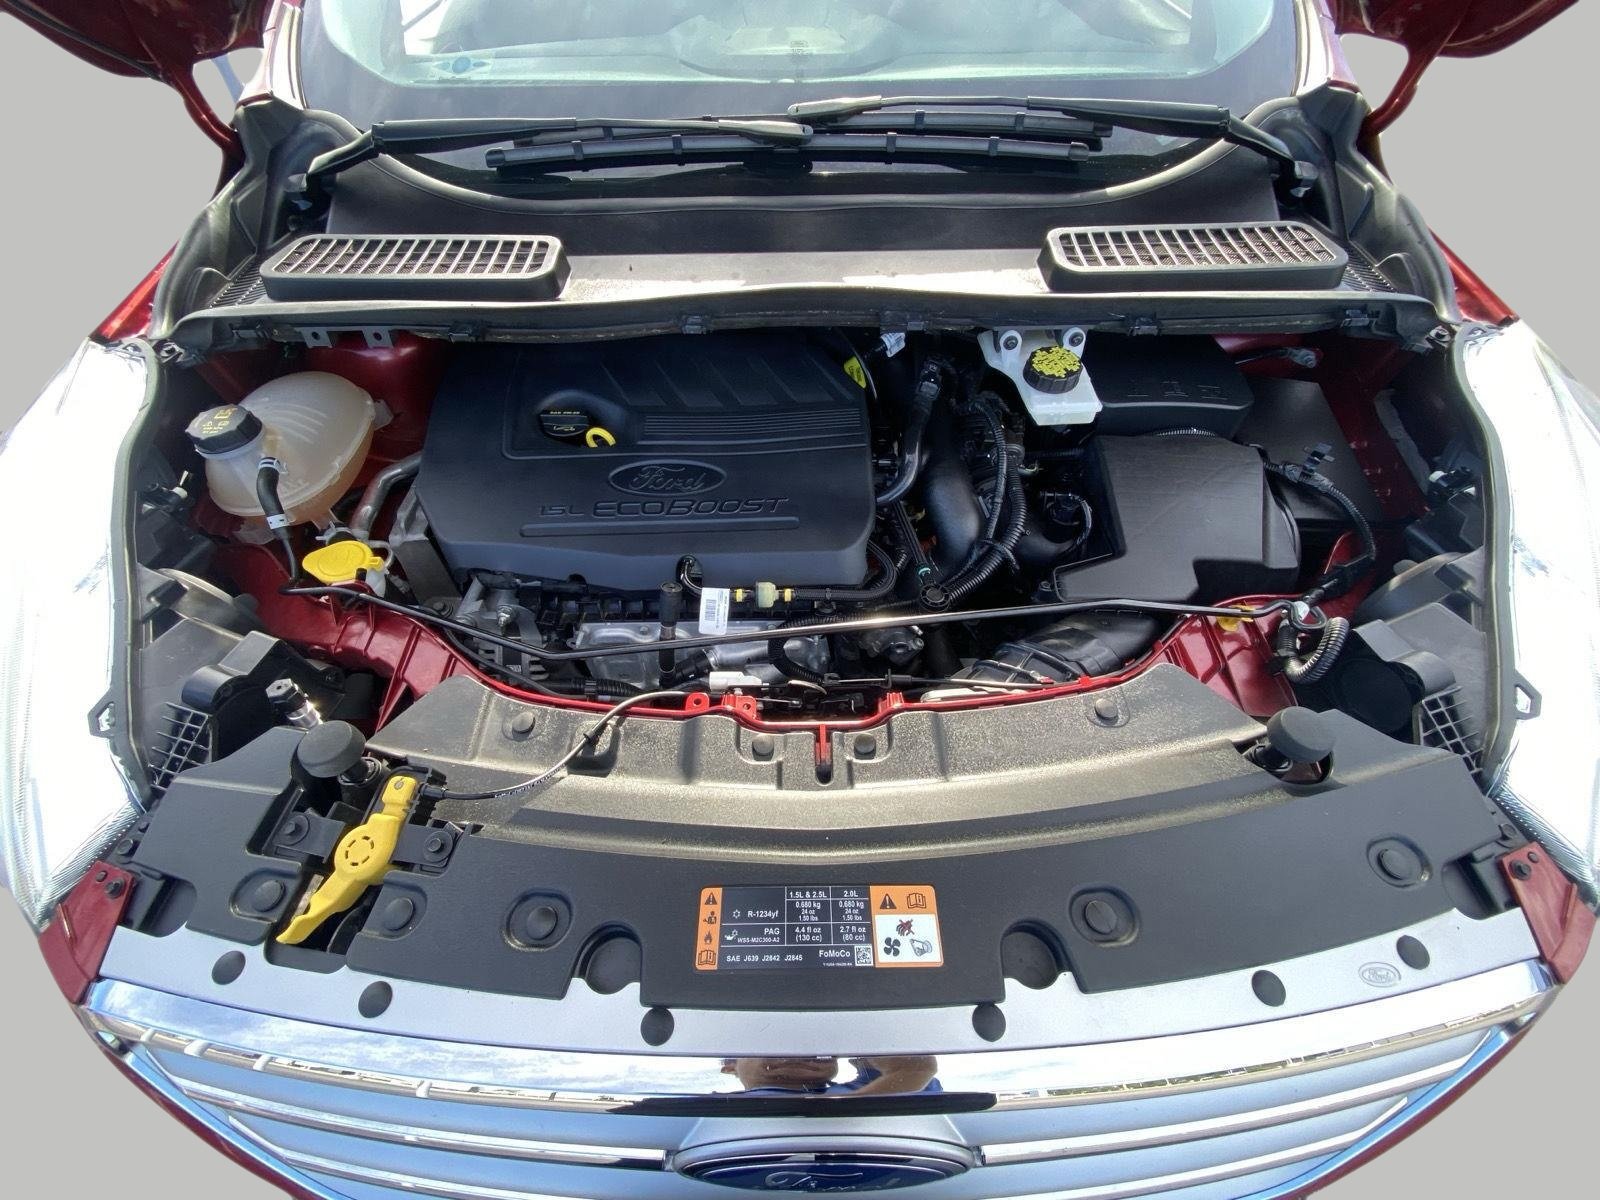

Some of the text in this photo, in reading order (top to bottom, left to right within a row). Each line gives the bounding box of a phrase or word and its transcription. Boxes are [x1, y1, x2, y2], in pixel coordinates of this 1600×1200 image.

[629, 465, 706, 491] Ford
[812, 901, 821, 909] kg
[838, 900, 865, 909] 0.680 kg
[747, 910, 779, 919] R-1234yf
[764, 927, 780, 935] PAG
[796, 934, 822, 942] (130 cc)
[842, 933, 866, 942] (80 cc)
[761, 954, 780, 962] J2842
[818, 949, 851, 958] FoMoCo
